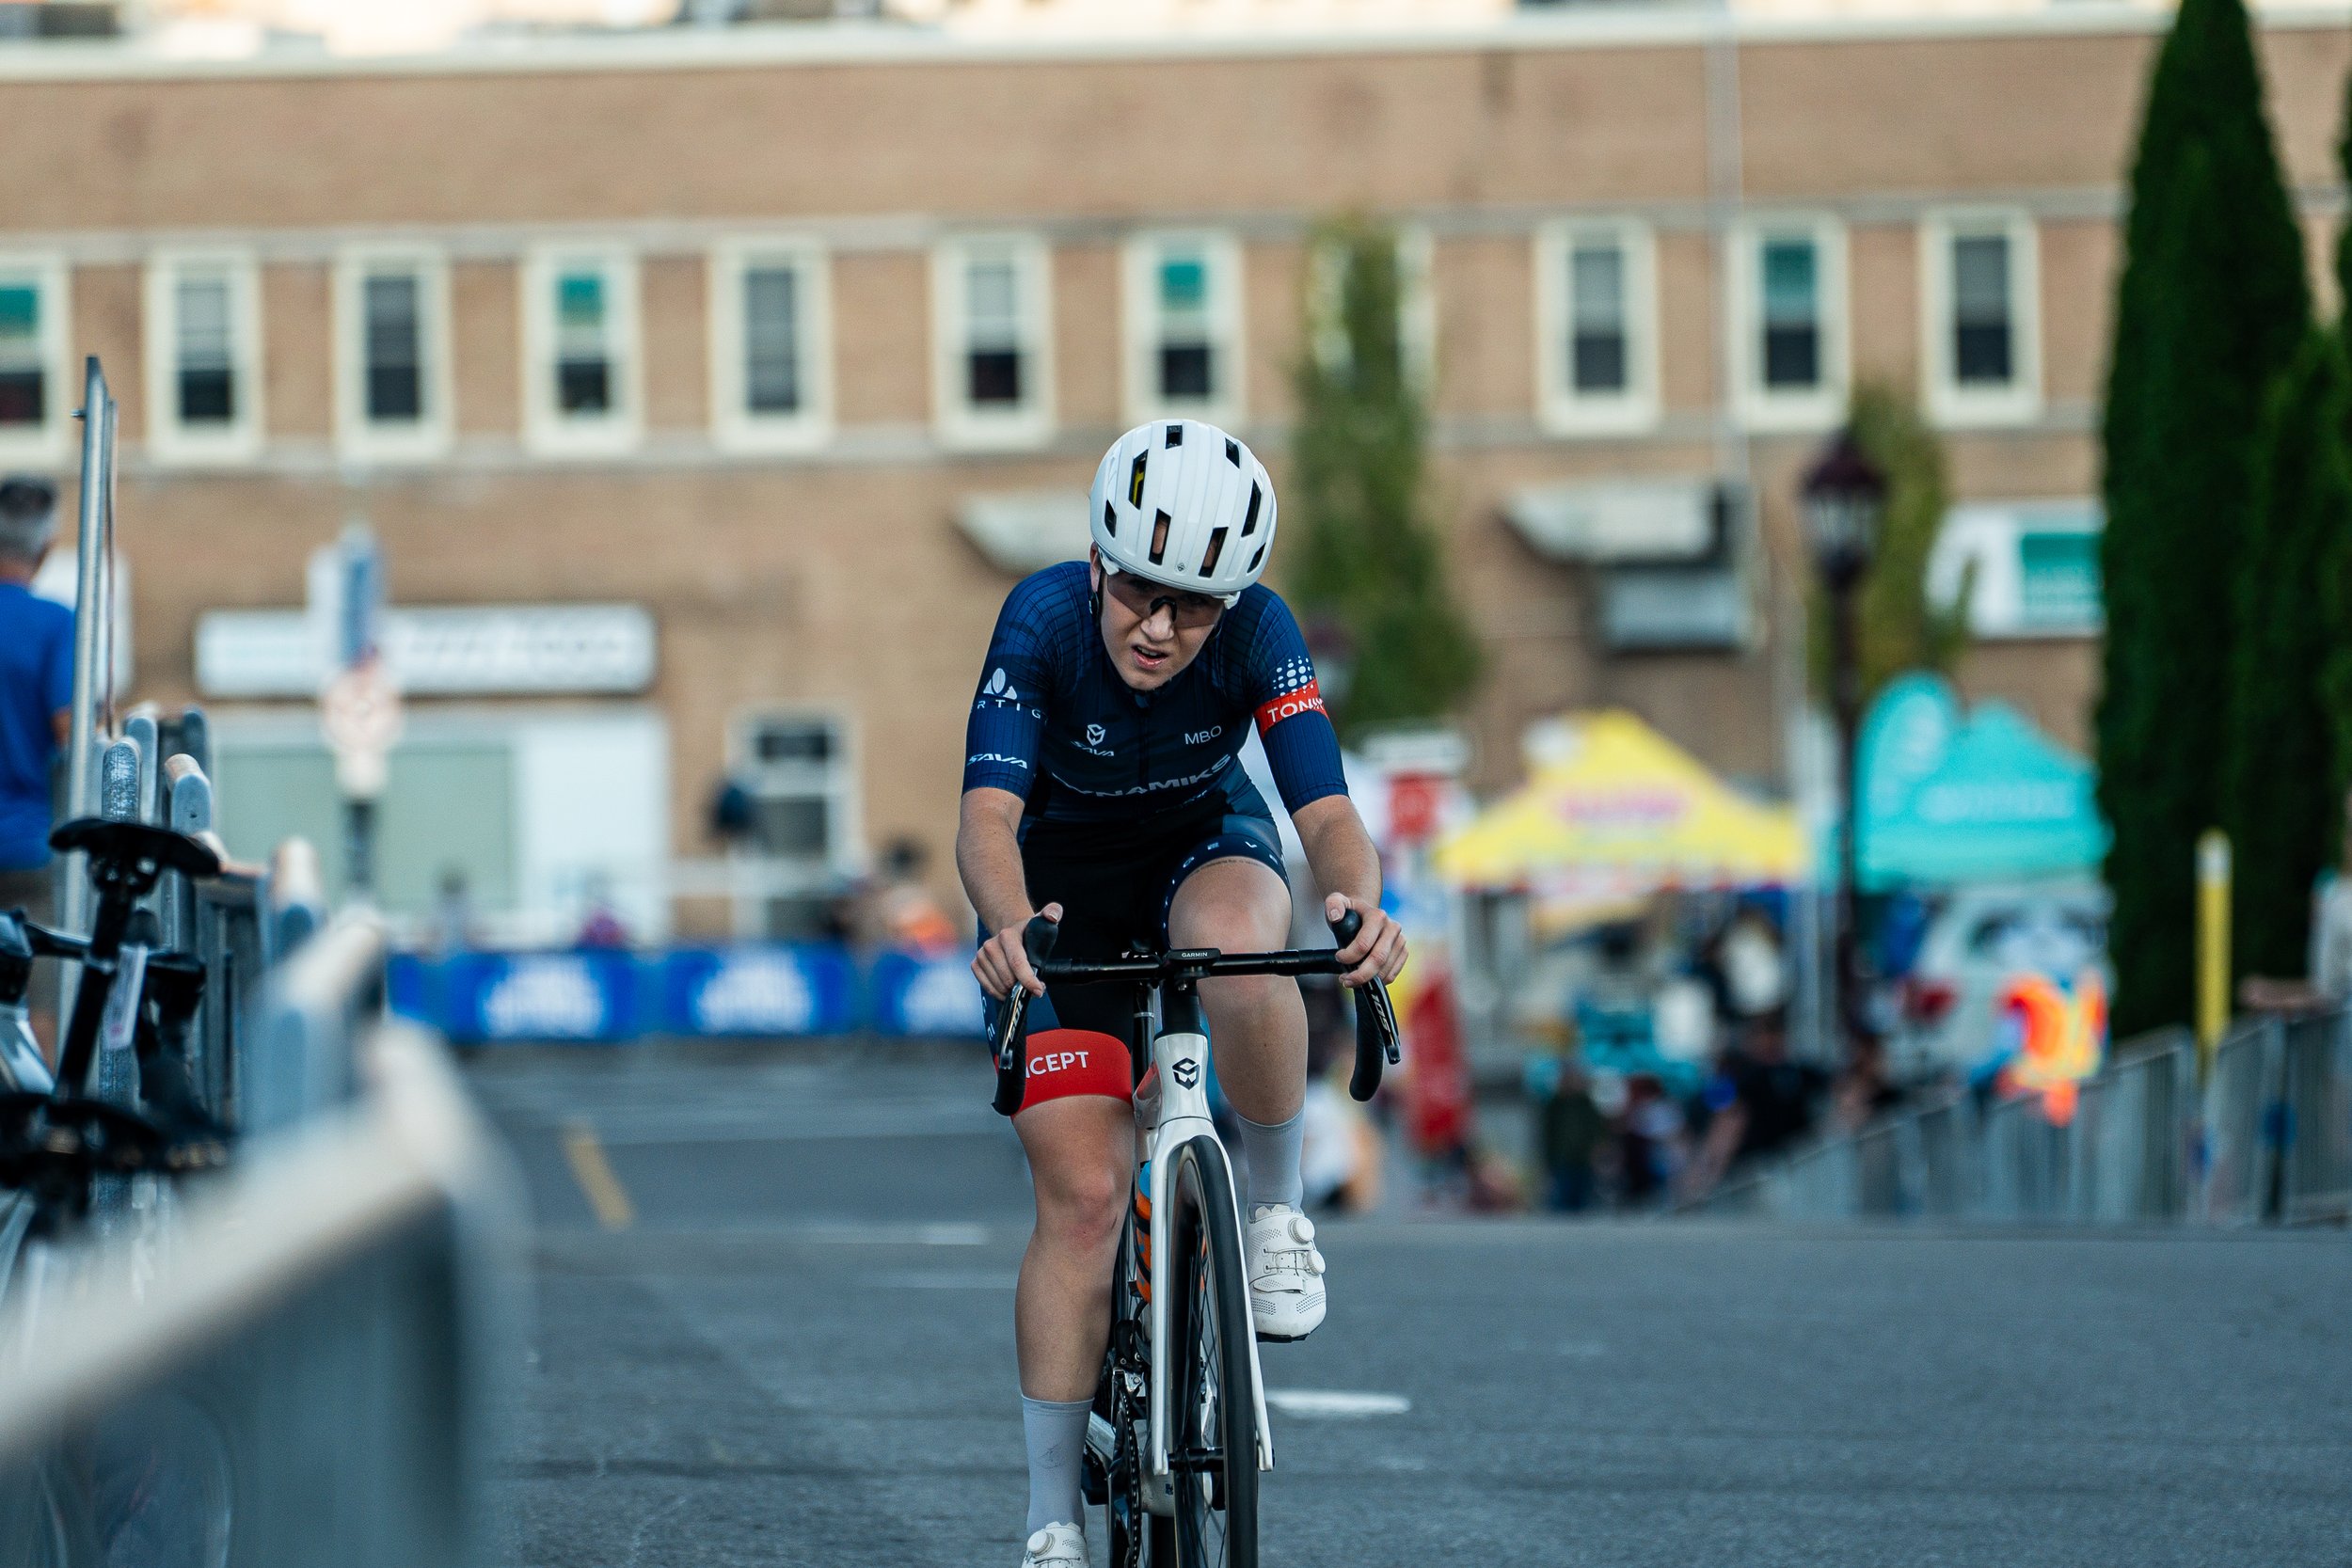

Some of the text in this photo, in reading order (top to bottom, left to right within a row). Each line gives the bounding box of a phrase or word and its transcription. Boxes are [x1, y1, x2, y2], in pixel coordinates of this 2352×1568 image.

[970, 699, 1048, 726] RTIG
[1184, 725, 1222, 745] MBO
[967, 752, 1027, 769] SAVA
[1371, 993, 1391, 1033] 105
